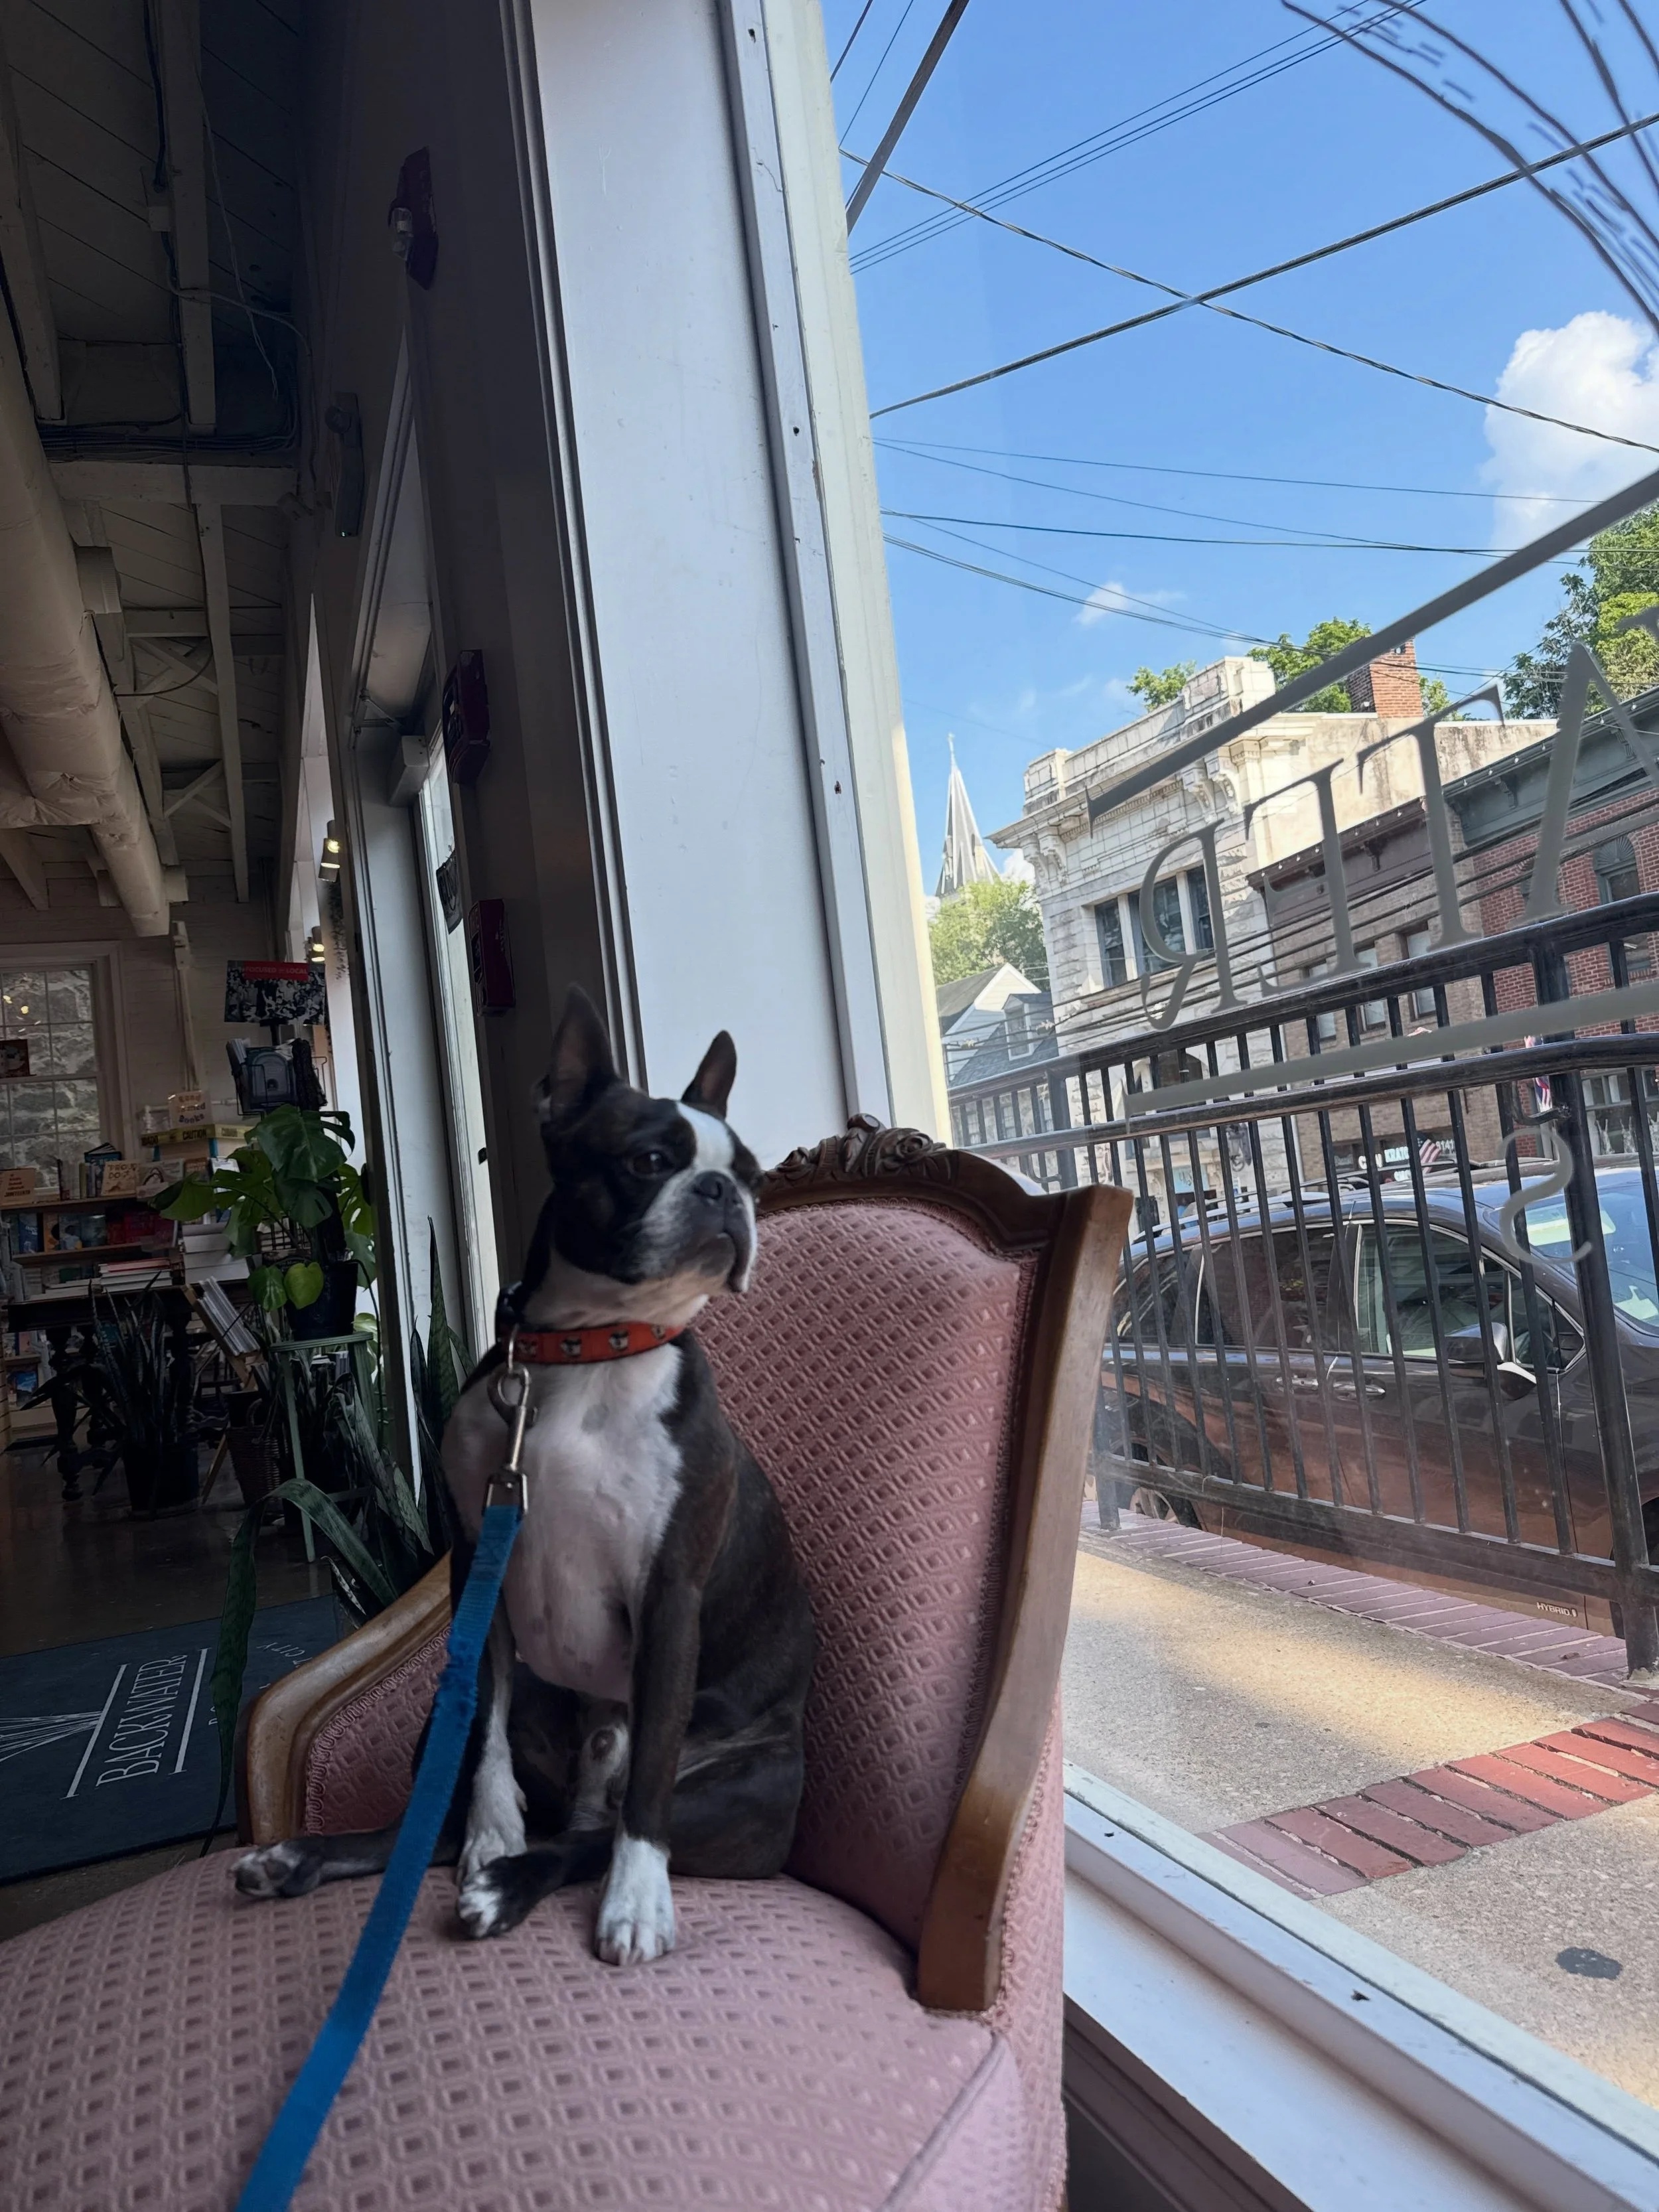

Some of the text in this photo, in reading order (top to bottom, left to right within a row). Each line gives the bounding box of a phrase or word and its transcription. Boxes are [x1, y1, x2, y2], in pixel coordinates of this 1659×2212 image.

[182, 1128, 206, 1140] CAUTION
[1537, 1601, 1570, 1616] HYBRID
[256, 1641, 306, 1658] CITY
[95, 1654, 188, 1787] BACKWATER
